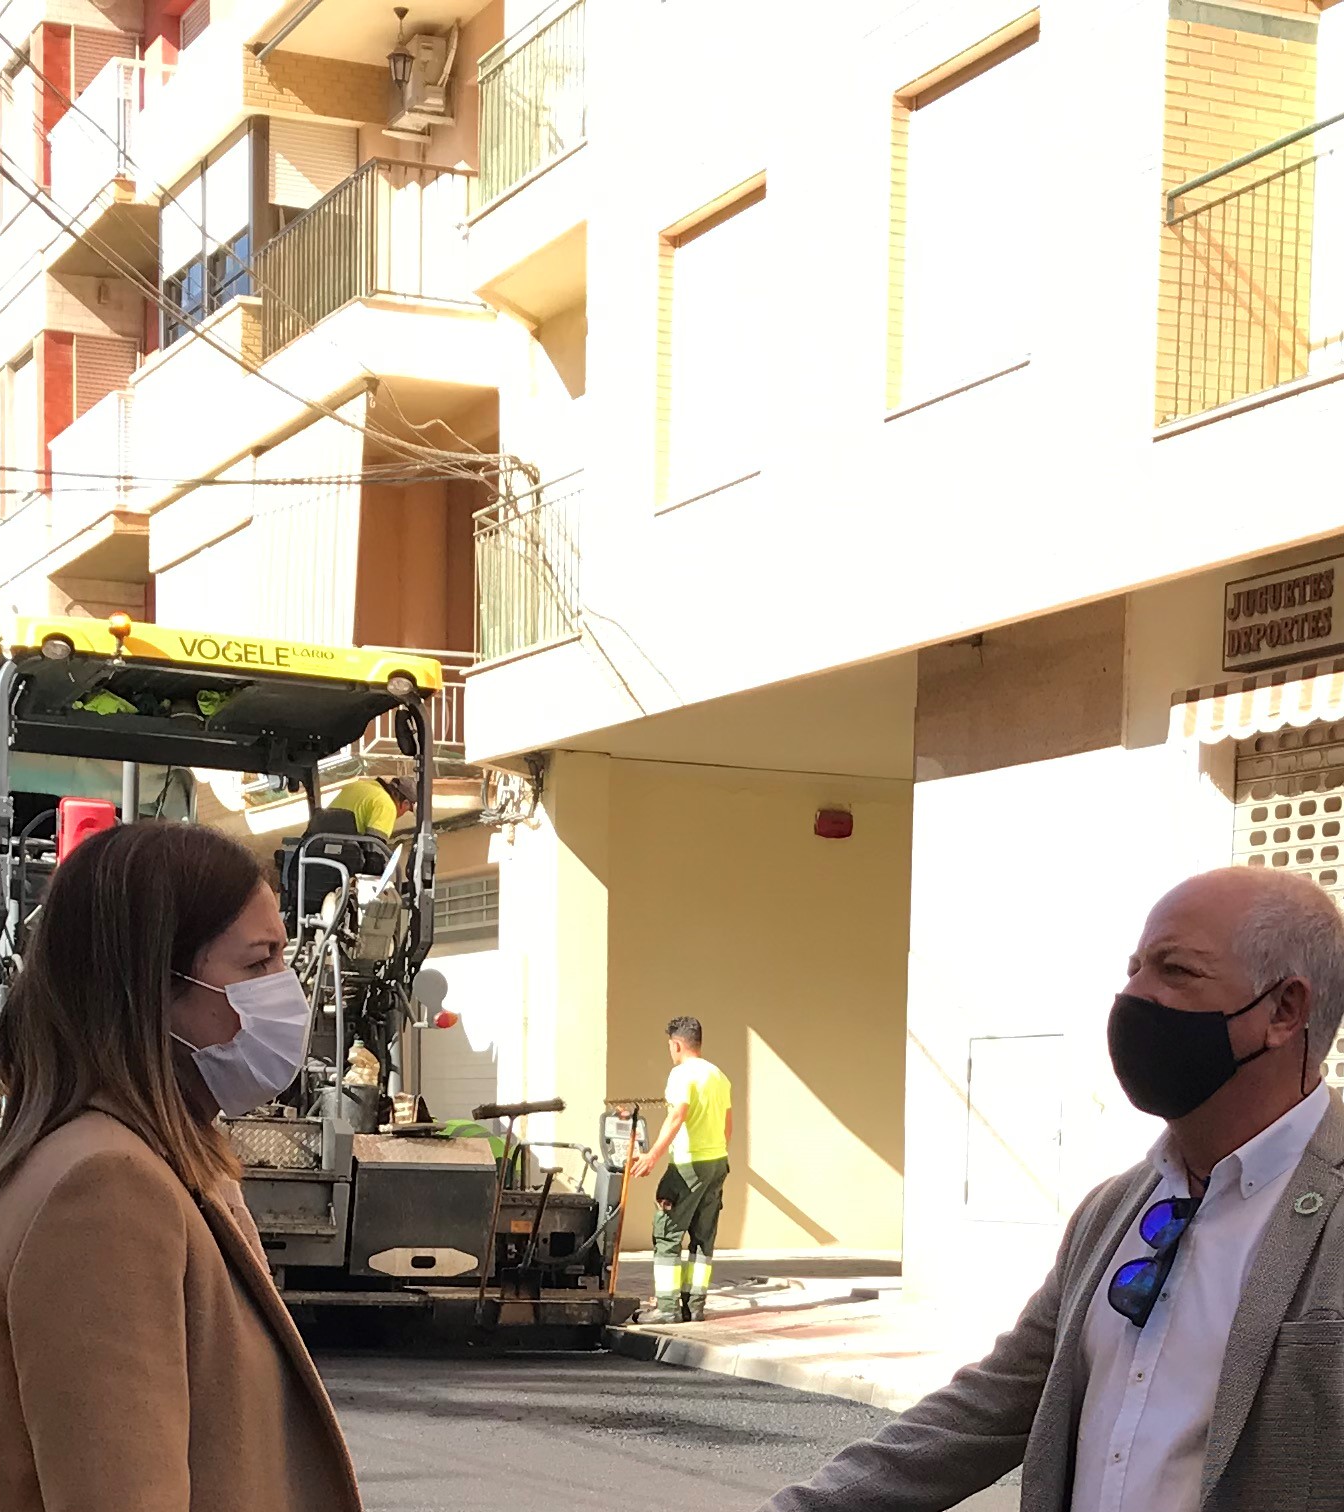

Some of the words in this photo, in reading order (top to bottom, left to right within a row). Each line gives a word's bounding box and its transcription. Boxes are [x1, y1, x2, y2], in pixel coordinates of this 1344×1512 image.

[1227, 568, 1335, 621] JUGUETES
[179, 634, 291, 668] VÖGELE
[292, 647, 335, 660] LARIO
[1226, 606, 1333, 658] DEPORTES
